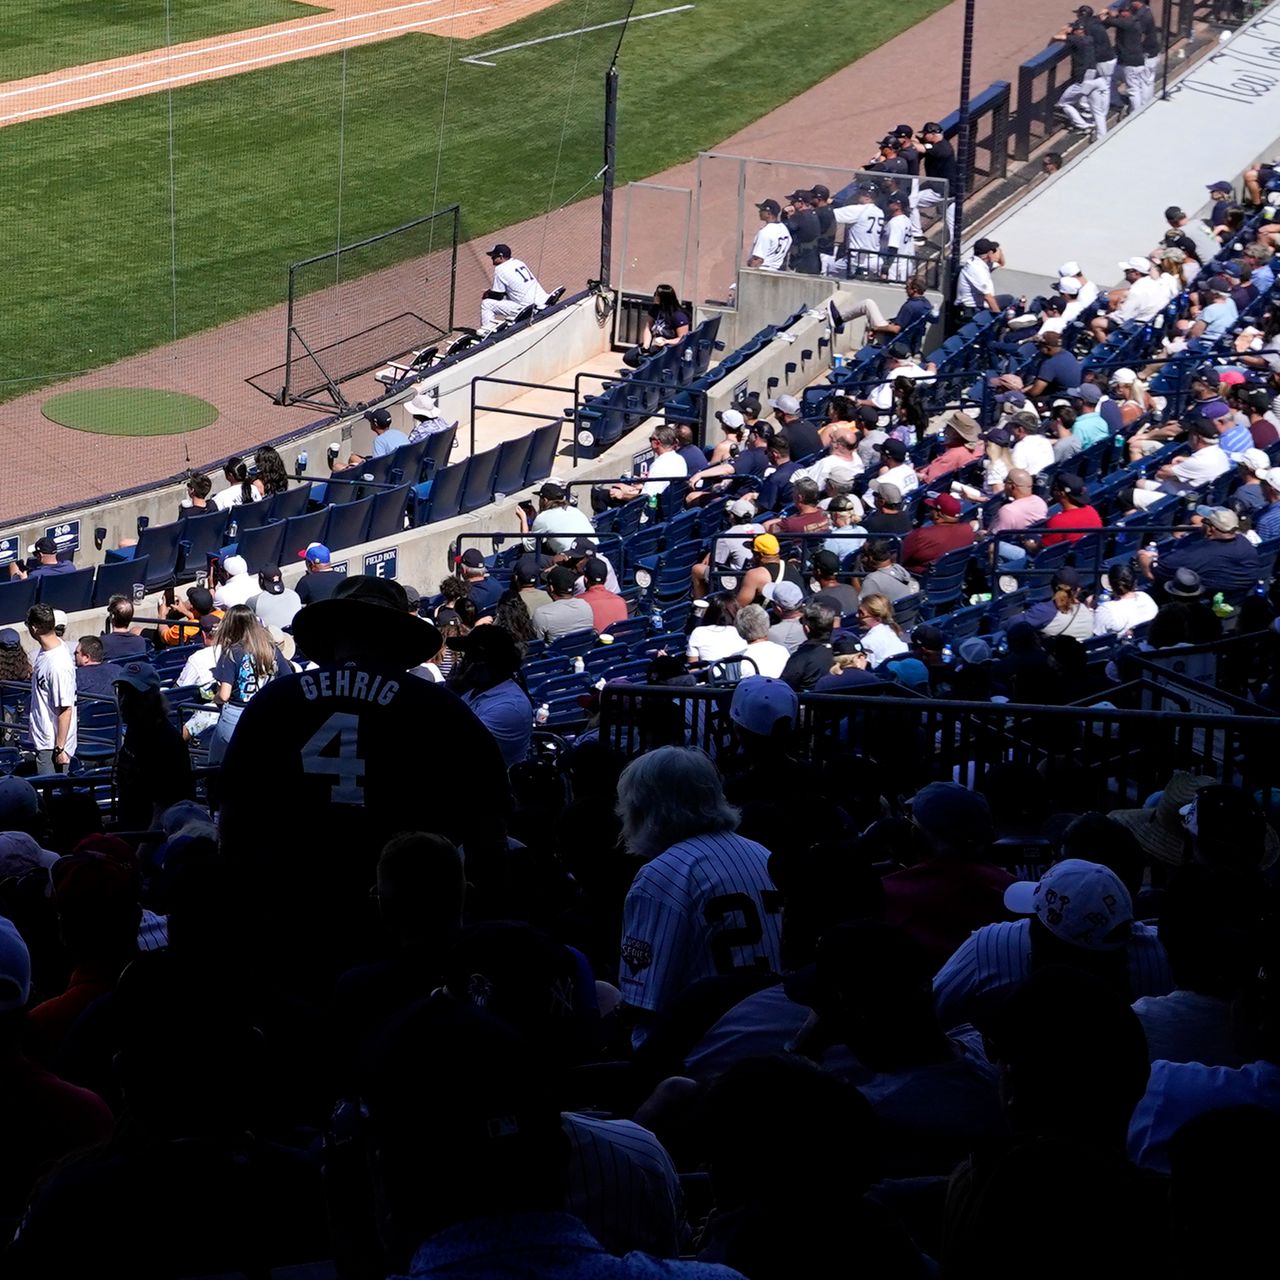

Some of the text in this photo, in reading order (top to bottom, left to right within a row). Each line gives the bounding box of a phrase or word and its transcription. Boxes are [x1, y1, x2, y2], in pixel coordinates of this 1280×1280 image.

[514, 265, 533, 282] 17
[365, 551, 396, 566] FIELD BOX
[376, 562, 386, 578] E
[300, 670, 400, 707] GEHRIG
[300, 711, 366, 805] 4
[622, 946, 653, 960] SERIES
